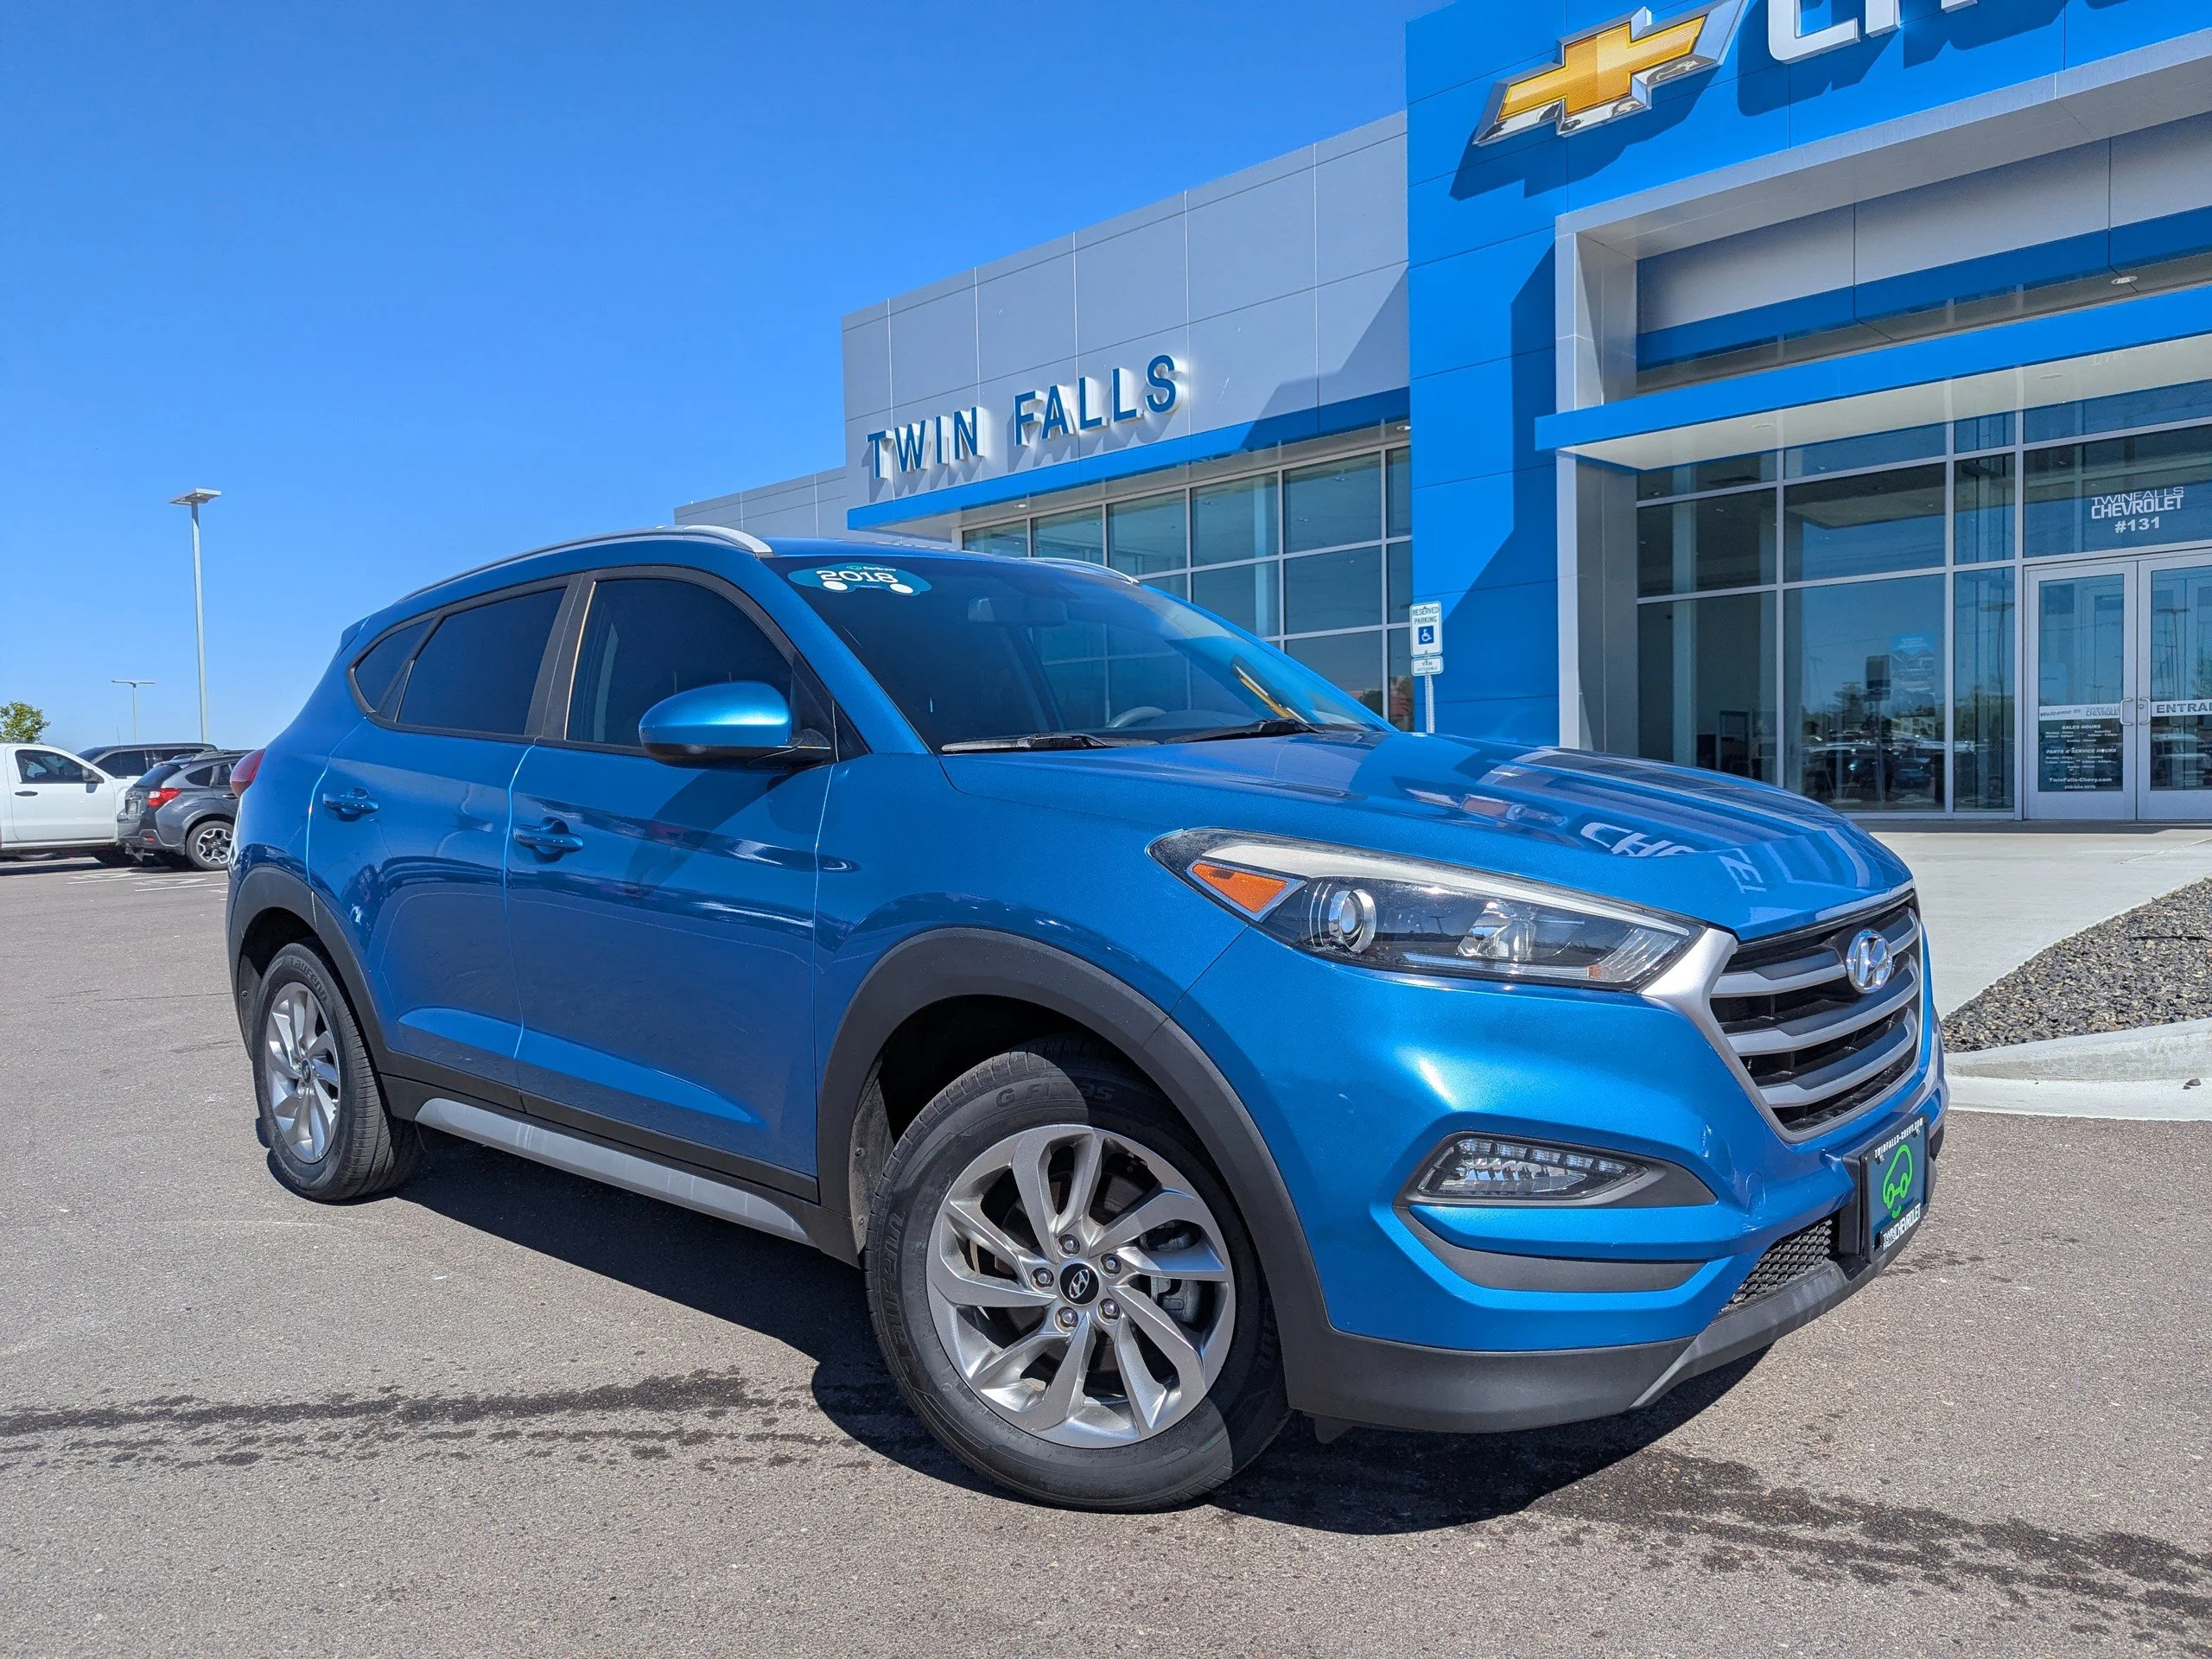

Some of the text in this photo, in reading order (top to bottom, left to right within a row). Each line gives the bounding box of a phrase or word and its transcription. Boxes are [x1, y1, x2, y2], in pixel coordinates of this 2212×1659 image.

[866, 354, 1179, 479] TWIN FALLS
[2091, 494, 2184, 519] CHEVROLET
[2114, 516, 2160, 533] #131
[816, 570, 899, 583] 2018
[1412, 607, 1439, 616] RESERVED
[1414, 615, 1437, 625] PARKING
[2156, 702, 2212, 714] ENTRA
[1894, 1202, 1921, 1240] CHEVROLET
